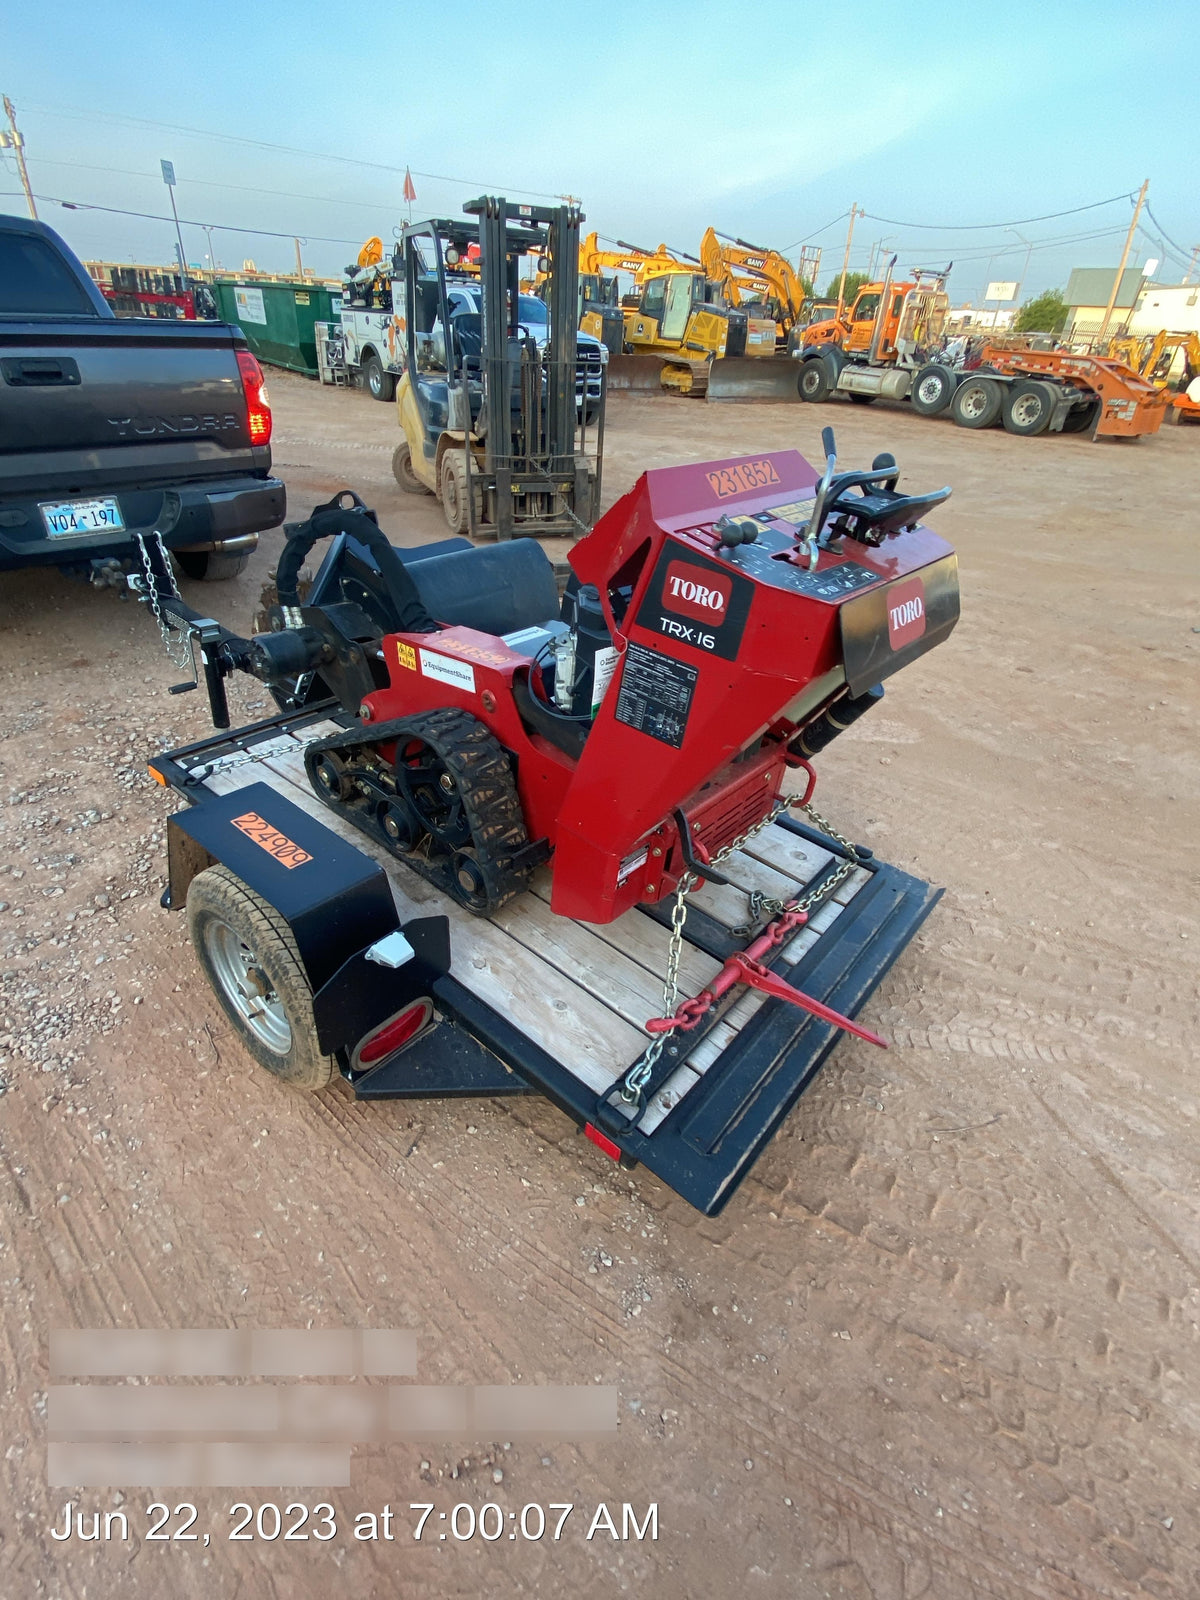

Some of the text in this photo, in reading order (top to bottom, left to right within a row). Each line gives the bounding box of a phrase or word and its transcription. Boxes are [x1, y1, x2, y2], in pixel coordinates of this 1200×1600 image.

[107, 413, 240, 435] TUNDRA
[709, 461, 779, 497] 231852
[669, 575, 724, 610] TORO
[890, 595, 923, 631] TORO
[427, 661, 472, 681] EquipmentShare
[233, 813, 309, 868] 224909
